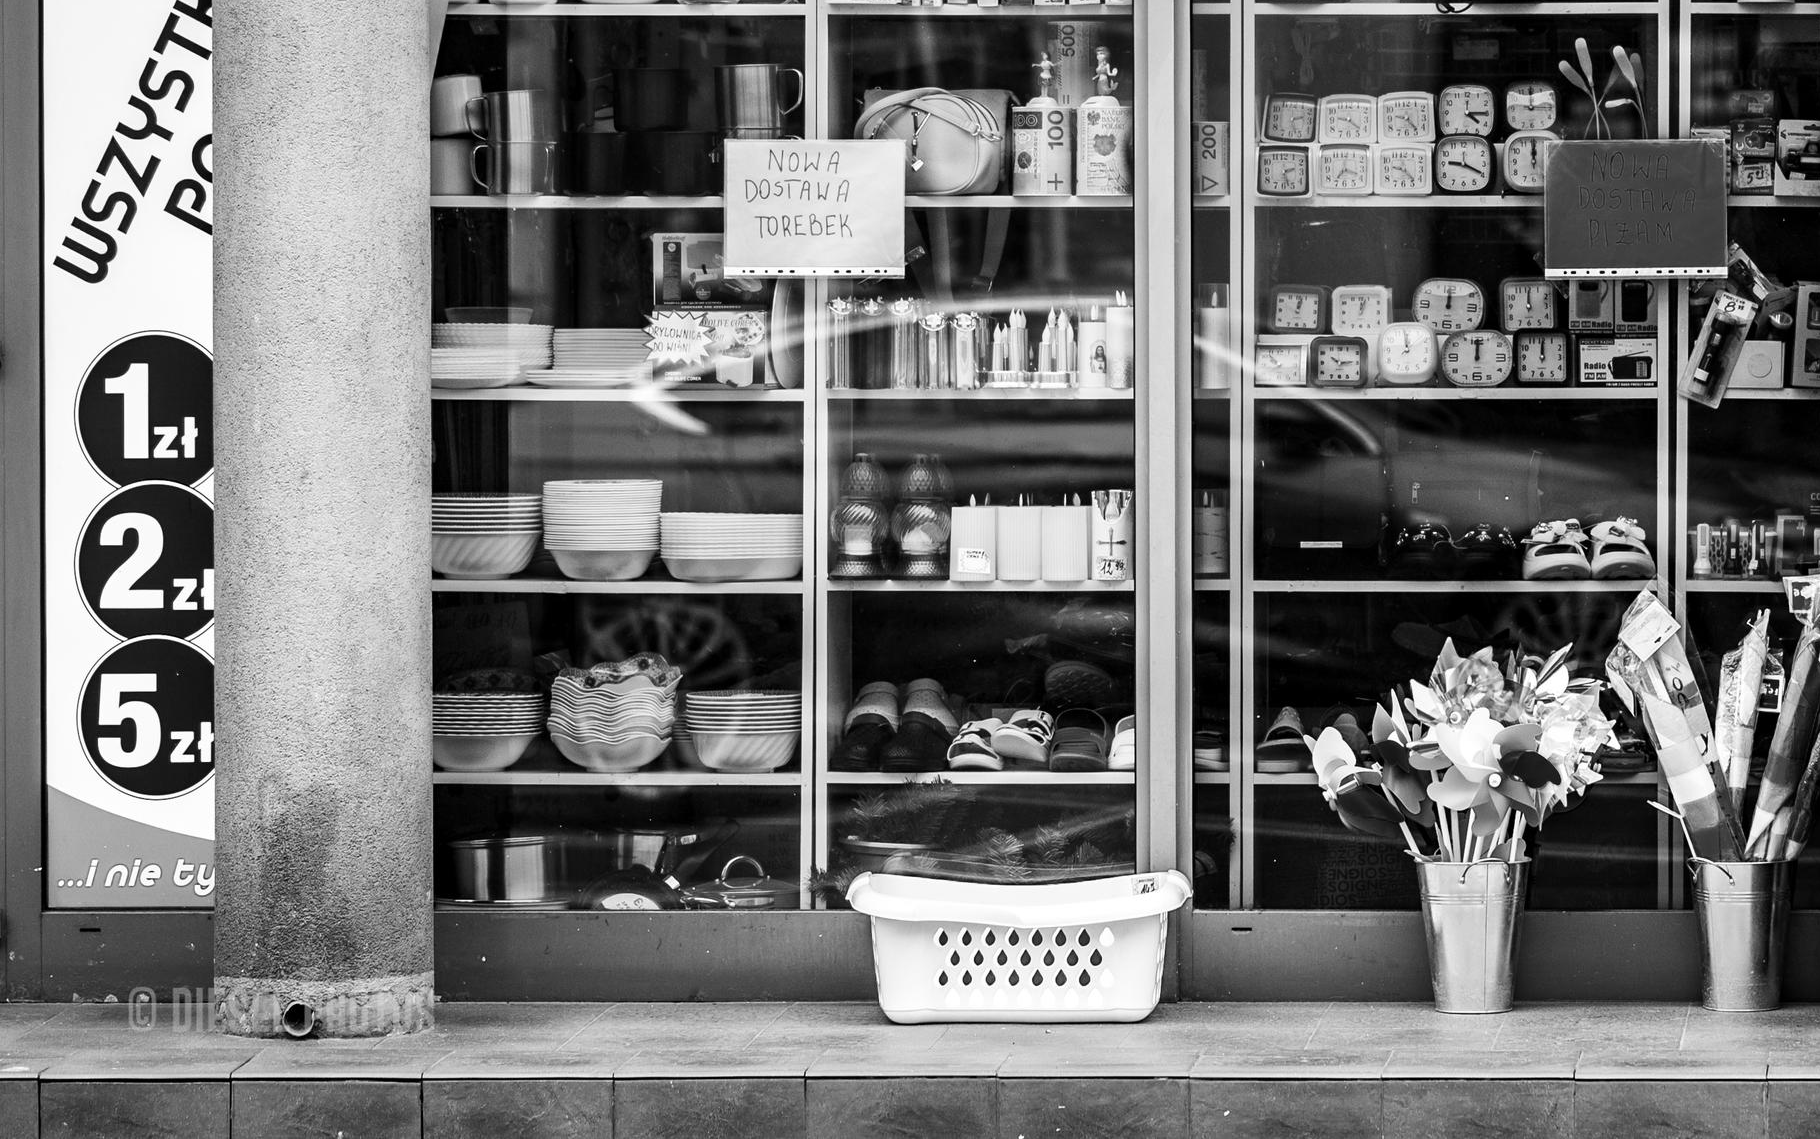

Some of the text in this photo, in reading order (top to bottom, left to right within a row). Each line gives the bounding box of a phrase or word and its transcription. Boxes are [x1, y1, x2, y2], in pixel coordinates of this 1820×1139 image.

[1062, 24, 1076, 57] 500
[1047, 110, 1064, 150] 100
[1201, 124, 1217, 160] 200
[768, 149, 841, 174] NOWA
[1591, 150, 1671, 182] NOWA
[745, 178, 850, 203] DOSTAWA
[1578, 186, 1697, 213] DOSTAWA
[754, 213, 853, 239] TOREBEK
[1724, 301, 1737, 313] 8
[653, 340, 664, 352] DO
[1584, 362, 1607, 370] Radio
[104, 859, 162, 887] nie
